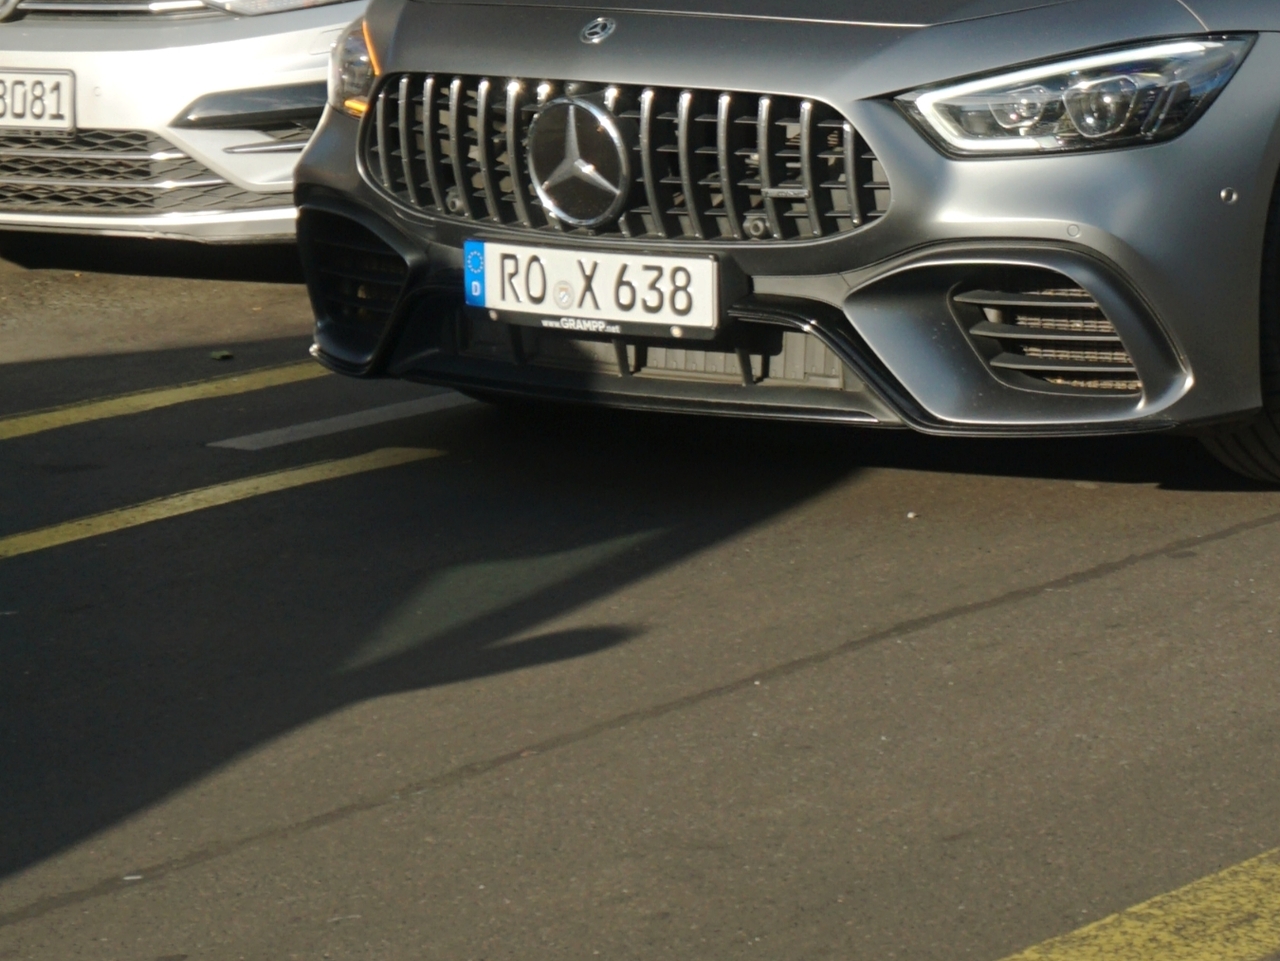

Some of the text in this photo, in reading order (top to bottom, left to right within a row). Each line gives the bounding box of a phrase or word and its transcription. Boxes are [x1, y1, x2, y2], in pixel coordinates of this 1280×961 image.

[471, 281, 481, 296] D
[500, 253, 693, 316] RO X 638
[541, 317, 620, 333] www.GRAMPP.net
